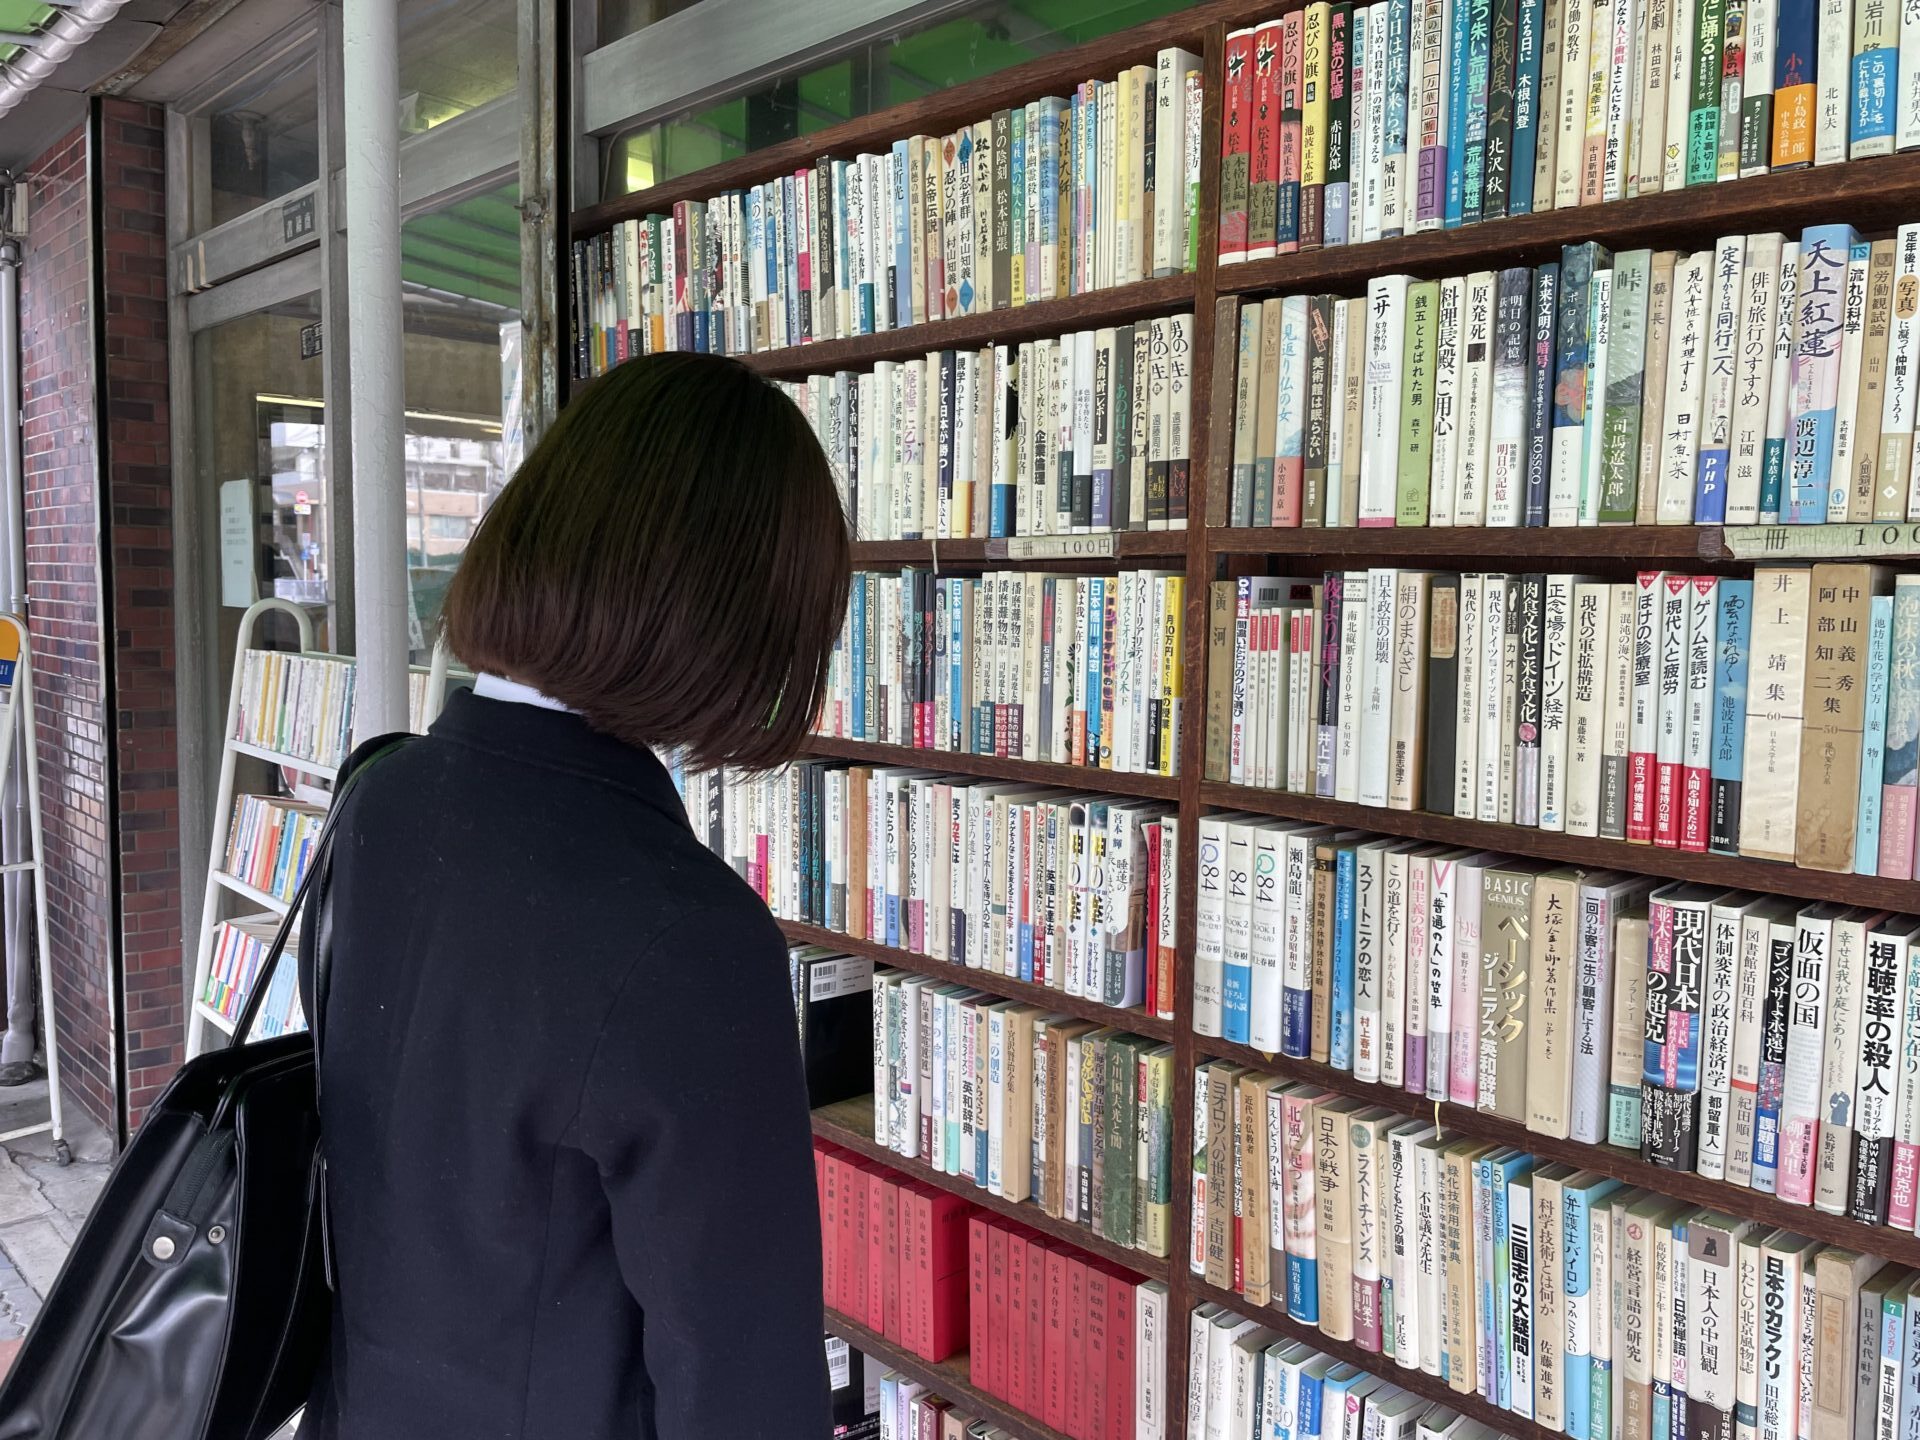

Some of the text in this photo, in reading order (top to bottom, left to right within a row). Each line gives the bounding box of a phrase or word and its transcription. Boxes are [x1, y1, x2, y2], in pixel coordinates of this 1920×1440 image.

[1283, 21, 1299, 87] 忍びの旗
[1305, 12, 1320, 79] 忍びの旗
[1330, 12, 1346, 101] 黒い森の記憶
[1328, 119, 1343, 171] 赤川次郎
[1516, 74, 1532, 130] 木根尚登
[1824, 87, 1838, 130] 北杜夫
[1303, 124, 1315, 184] 池波正太郎
[1383, 160, 1397, 217] 城山三郎
[1587, 145, 1599, 196] 中日新聞連載
[1469, 285, 1490, 341] 原発死
[1536, 274, 1554, 369] 未来文明の暗号
[1597, 281, 1610, 345] EUを考える
[1616, 268, 1642, 293] 峠
[1774, 263, 1798, 360] 私の写真入門
[1797, 238, 1846, 358] 天上紅蓮
[1845, 267, 1865, 335] 流れの科学
[1151, 323, 1169, 380] 男の一生
[1171, 320, 1189, 378] 男の一生
[1410, 296, 1428, 406] 銭五とよばれた男
[1434, 285, 1459, 437] 料理長殿、ご用心
[1507, 295, 1523, 360] 明日の記憶
[1740, 271, 1770, 408] 俳句旅行のすすめ
[1279, 322, 1299, 422] 見返り仏の女
[1309, 356, 1326, 459] 美術館は眠らない
[1494, 443, 1509, 502] 明日の記憶
[1531, 435, 1544, 485] ROSSCO
[1608, 418, 1628, 498] 司馬遼太郎
[1791, 418, 1817, 490] 渡辺淳一
[1374, 575, 1392, 664] 日本政治の崩壊
[1398, 584, 1416, 693] 絹のまなざし
[1519, 581, 1539, 723] 肉食文化と米食文化
[1543, 584, 1567, 731] 正念場のドイツ経済
[1575, 594, 1597, 702] 現代の軍拡構造
[1618, 613, 1631, 662] 混沌の海へ
[1634, 593, 1653, 687] ぼけの診療室
[1662, 599, 1682, 696] 現代人と疲労
[1690, 599, 1710, 690] ゲノムを読む
[1870, 616, 1887, 704] 池坊生花の学び方
[1718, 695, 1736, 761] 池波正太郎
[1658, 765, 1672, 832] 健康維持の知恵
[1686, 770, 1701, 840] 人間を知るために
[1288, 847, 1303, 911] 瀬島龍三
[1387, 863, 1402, 947] この道を行く
[1410, 868, 1425, 958] 自由主義の夜明け
[1484, 875, 1530, 896] BASIC
[1487, 893, 1526, 907] GENIUS
[1357, 864, 1374, 998] スプートニクの恋人
[1430, 891, 1449, 1010] 「普通の人」の哲学
[1652, 905, 1671, 973] 並木信義
[1670, 909, 1703, 1012] 現代日本
[1497, 913, 1530, 1044] ベーシック
[1580, 896, 1600, 1056] 一回のお客を一生の顧客にする法
[1706, 922, 1735, 1087] 体制変革の政治経済学
[1740, 928, 1759, 1024] 図書館活用百科
[1766, 941, 1793, 1062] ゴンベッサよ永遠に
[1793, 927, 1823, 1030] 仮面の国
[1862, 941, 1898, 1096] 視聴率の殺人
[1359, 1016, 1371, 1061] 村上春樹
[962, 1080, 974, 1137] 英和辞典
[1705, 1094, 1722, 1149] 都留重人
[1733, 1097, 1752, 1162] 紀田順一郎
[1318, 1116, 1339, 1193] 日本の戦争
[1892, 1147, 1913, 1208] 野村克也
[1356, 1153, 1373, 1263] ラストチャンス
[1418, 1191, 1433, 1276] 不思議な先生
[1447, 1163, 1461, 1265] 緑化技術用語事典
[1511, 1223, 1530, 1357] 三国志の大疑問
[1539, 1197, 1556, 1316] 科学技術とは何か
[1626, 1246, 1643, 1363] 経営言語の研究
[1673, 1297, 1686, 1357] 日常禅語
[1700, 1268, 1720, 1376] 日本人の中国観
[1739, 1259, 1755, 1374] わたしの北京風物誌
[1764, 1255, 1785, 1380] 日本のカラクリ
